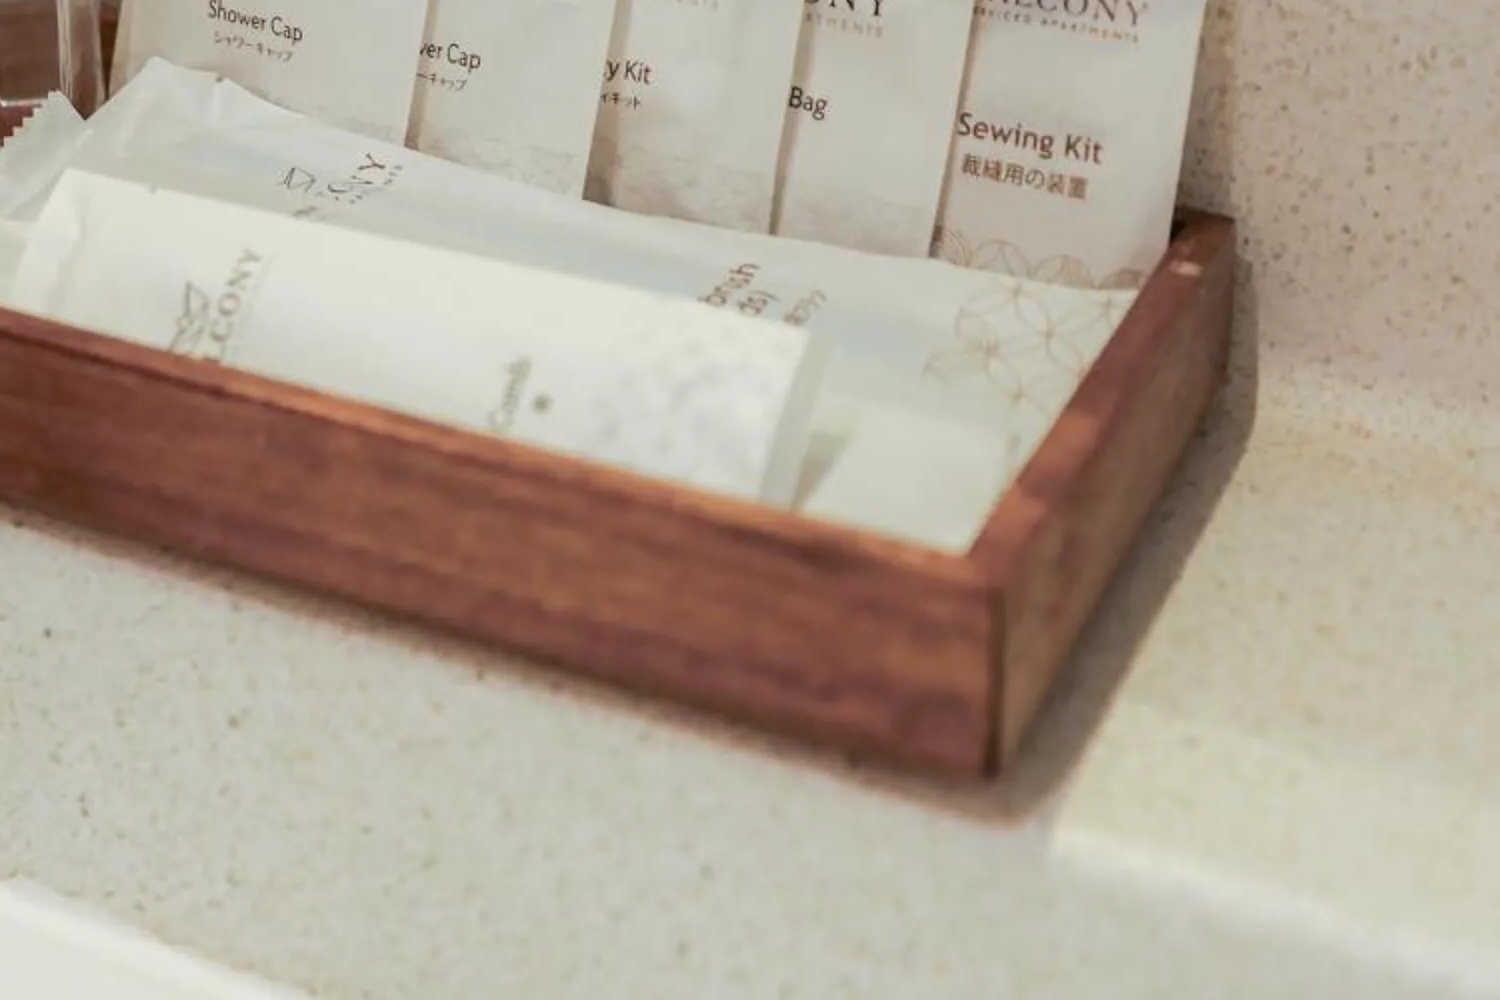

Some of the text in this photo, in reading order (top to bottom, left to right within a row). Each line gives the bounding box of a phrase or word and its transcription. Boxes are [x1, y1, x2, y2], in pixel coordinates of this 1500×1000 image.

[270, 15, 304, 47] Cap
[446, 42, 481, 76] Cap
[622, 60, 652, 85] Kit
[789, 86, 828, 121] Bag
[957, 111, 1104, 165] Sewing Kit
